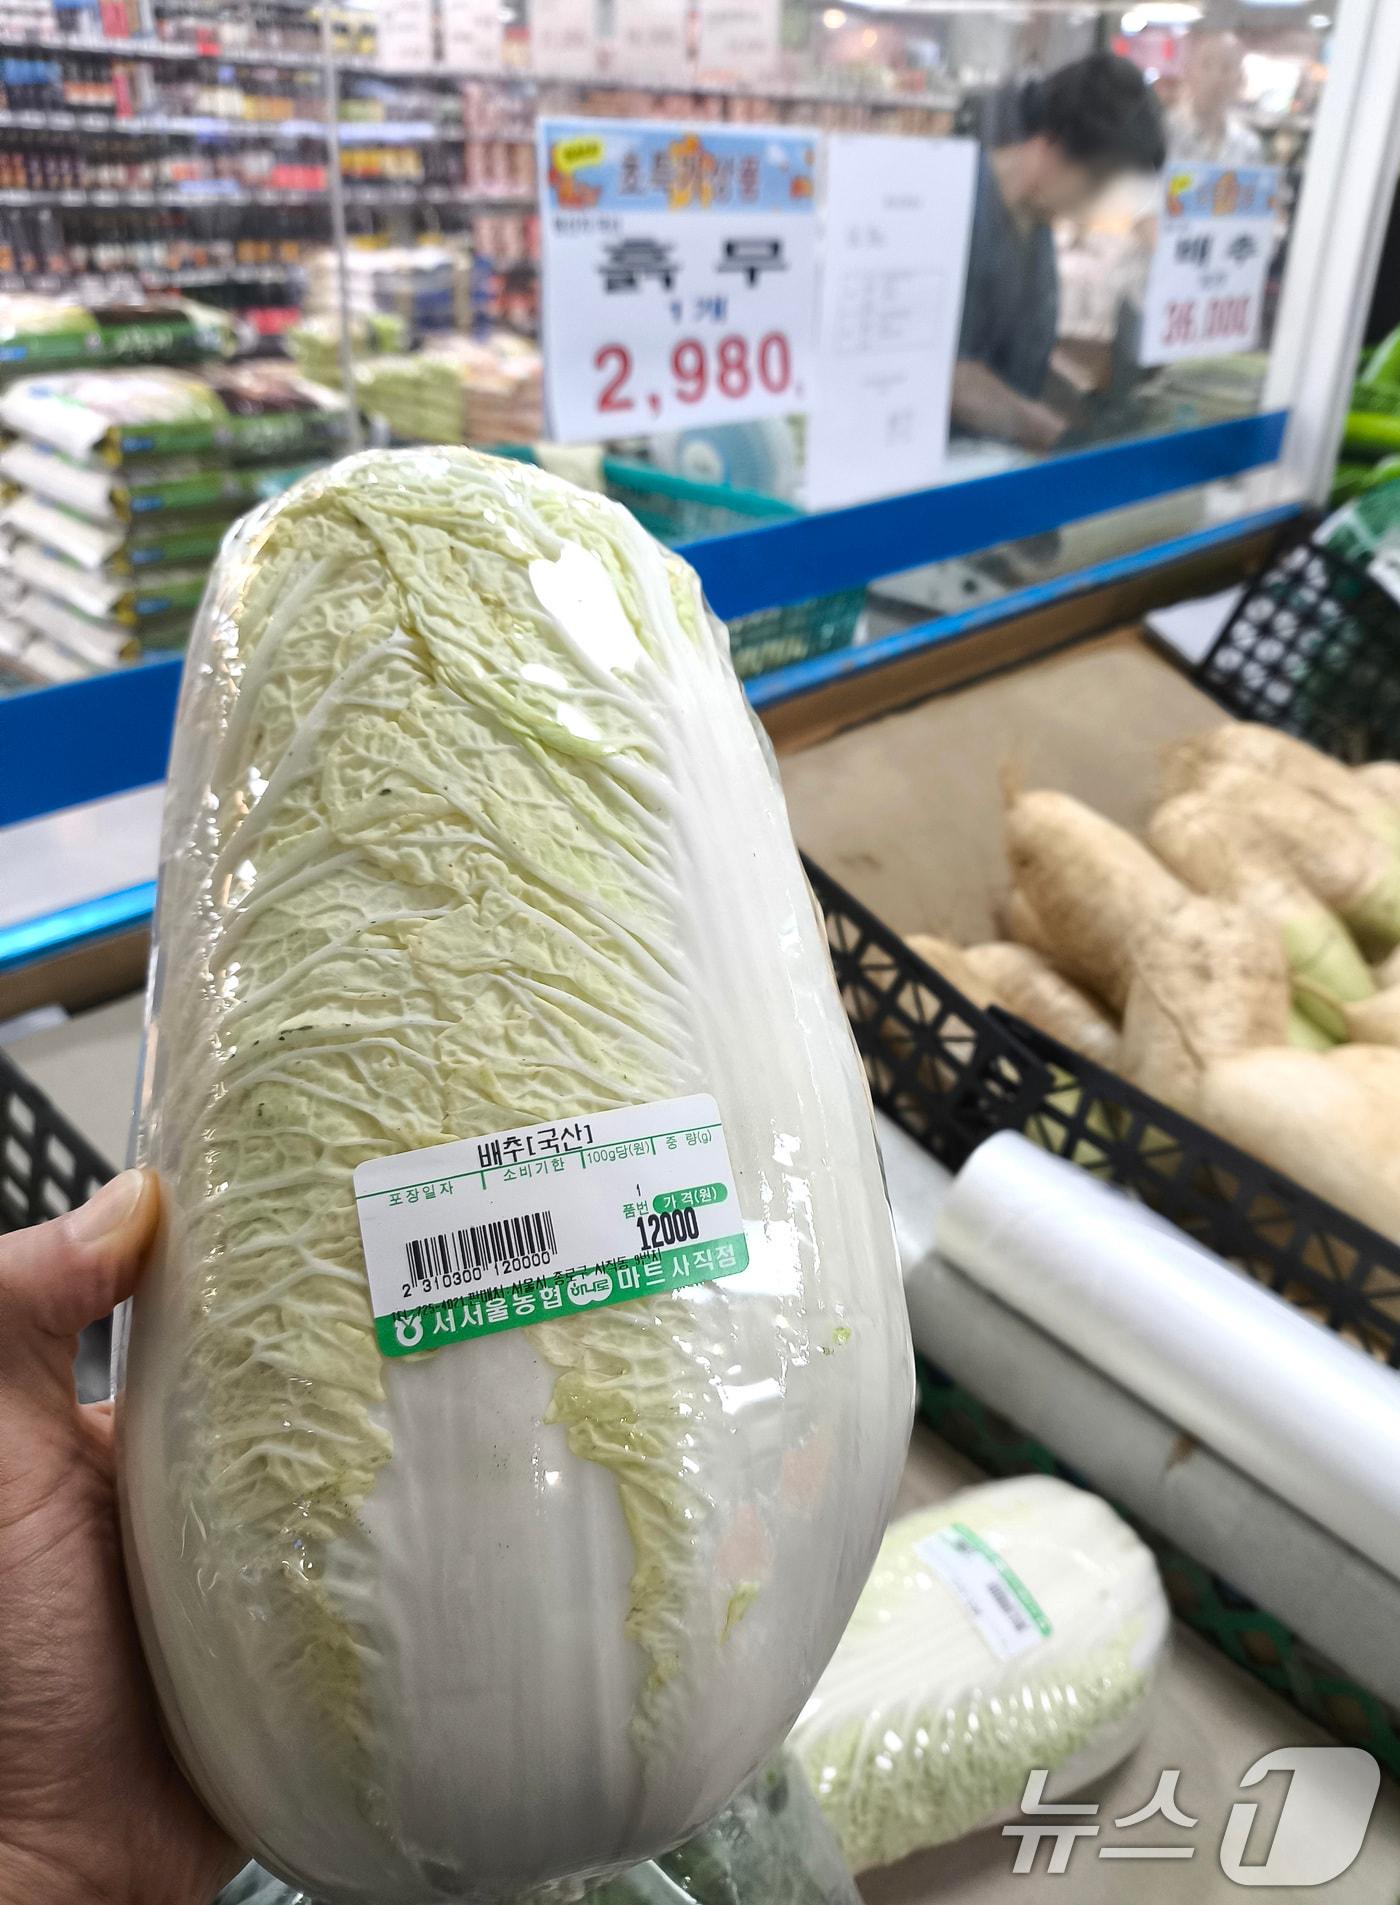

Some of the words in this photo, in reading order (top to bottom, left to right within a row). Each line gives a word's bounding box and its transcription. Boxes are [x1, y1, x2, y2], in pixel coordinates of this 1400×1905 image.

[593, 330, 792, 417] 2,980
[477, 1123, 594, 1168] 배추[국산]
[587, 1140, 651, 1164] 100g당(원)
[503, 1157, 566, 1182] 소비기한
[388, 1180, 454, 1207] 포장일자
[623, 1200, 649, 1219] 품번
[636, 1206, 700, 1251] 12000
[432, 1285, 563, 1334] 서서울농협
[616, 1261, 666, 1289] 마트
[672, 1243, 737, 1278] 사직점
